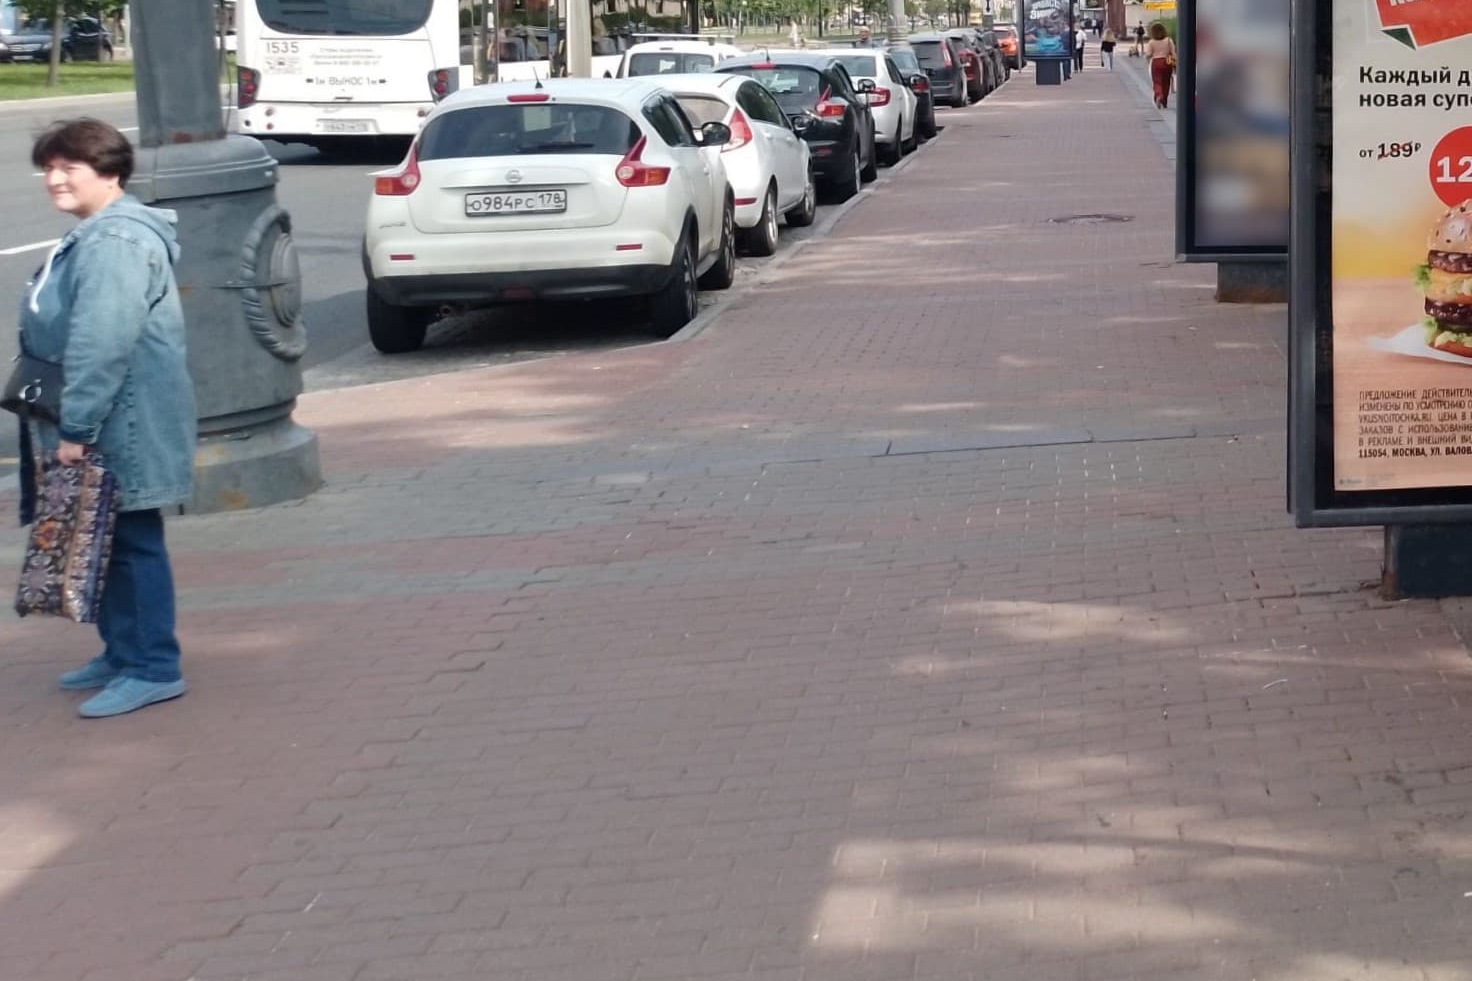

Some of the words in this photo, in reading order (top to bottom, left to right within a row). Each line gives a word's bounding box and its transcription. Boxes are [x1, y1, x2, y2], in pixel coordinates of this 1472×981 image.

[266, 41, 300, 54] 1535
[328, 77, 364, 85] ВЫНОС
[1359, 66, 1450, 87] Каждый
[1359, 93, 1426, 108] новая
[1359, 148, 1374, 158] от
[538, 193, 561, 204] 178
[1360, 389, 1416, 400] ПРЕДЛОЖЕНИЕ
[1403, 401, 1414, 410] ПО
[1438, 412, 1457, 422] ЦЕНА
[1368, 436, 1402, 446] РЕКЛАМЕ
[1418, 434, 1456, 445] ВНЕШНИЙ
[1359, 448, 1389, 458] 115054,
[1392, 447, 1427, 457] МОСКВА,
